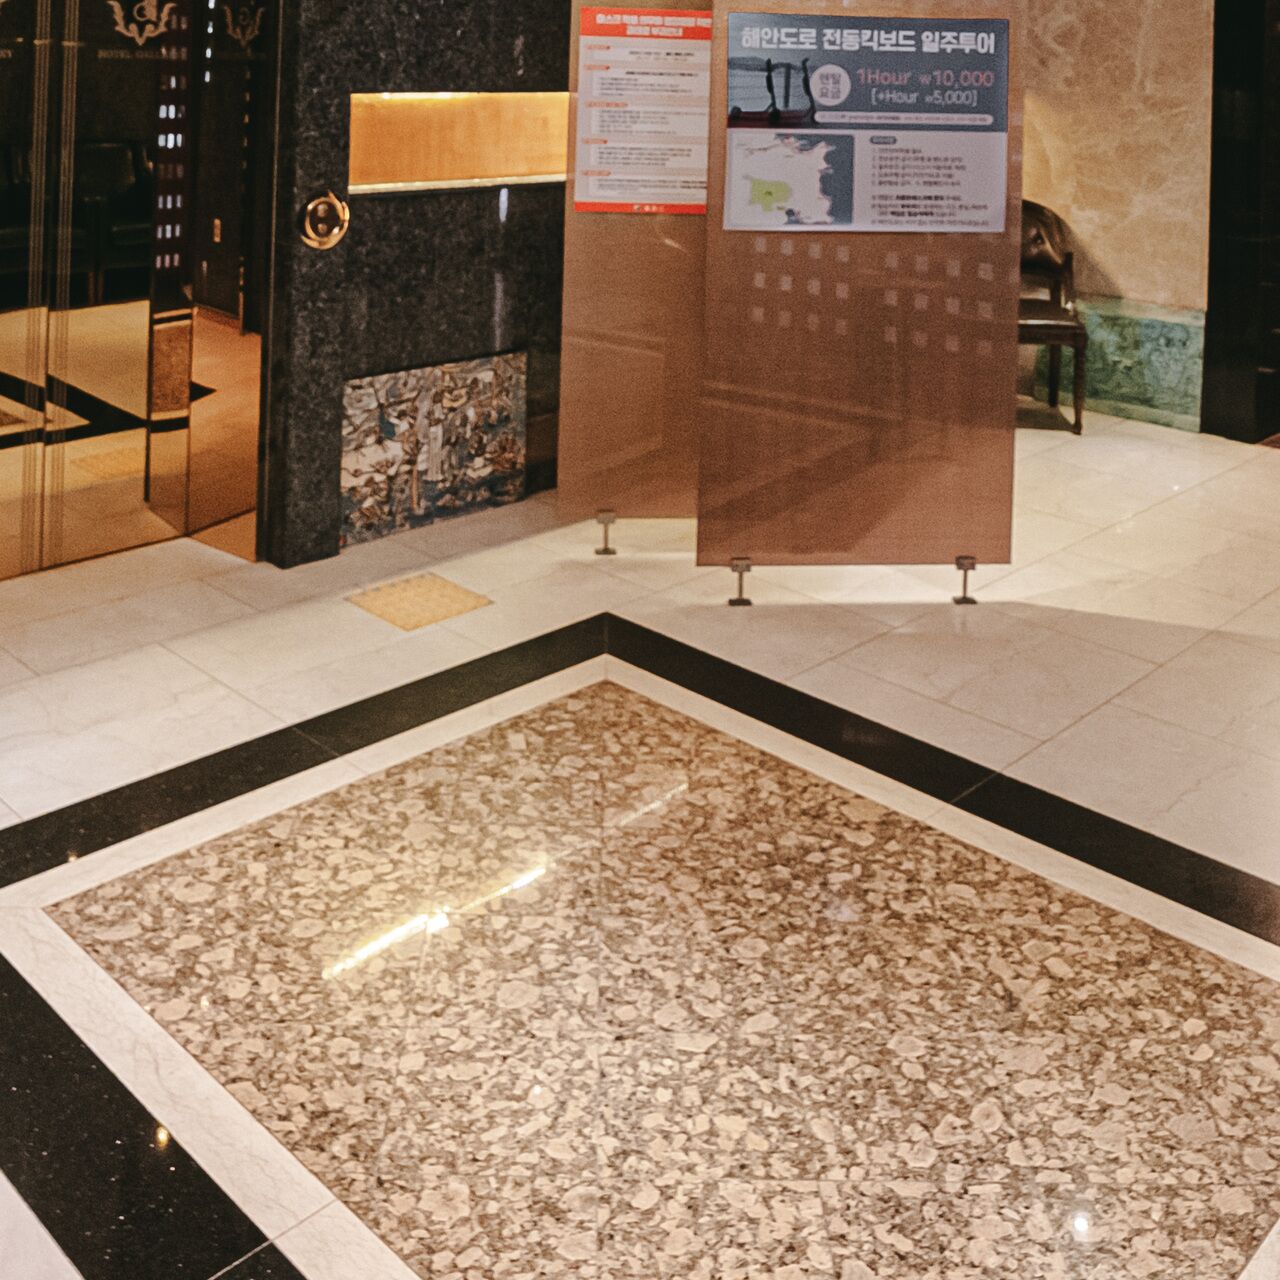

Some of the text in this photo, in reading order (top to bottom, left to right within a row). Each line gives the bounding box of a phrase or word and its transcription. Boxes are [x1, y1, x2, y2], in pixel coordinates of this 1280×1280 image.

[741, 26, 995, 54] 해안도로 전동킥보드 일주투어
[856, 67, 912, 86] 1Hour
